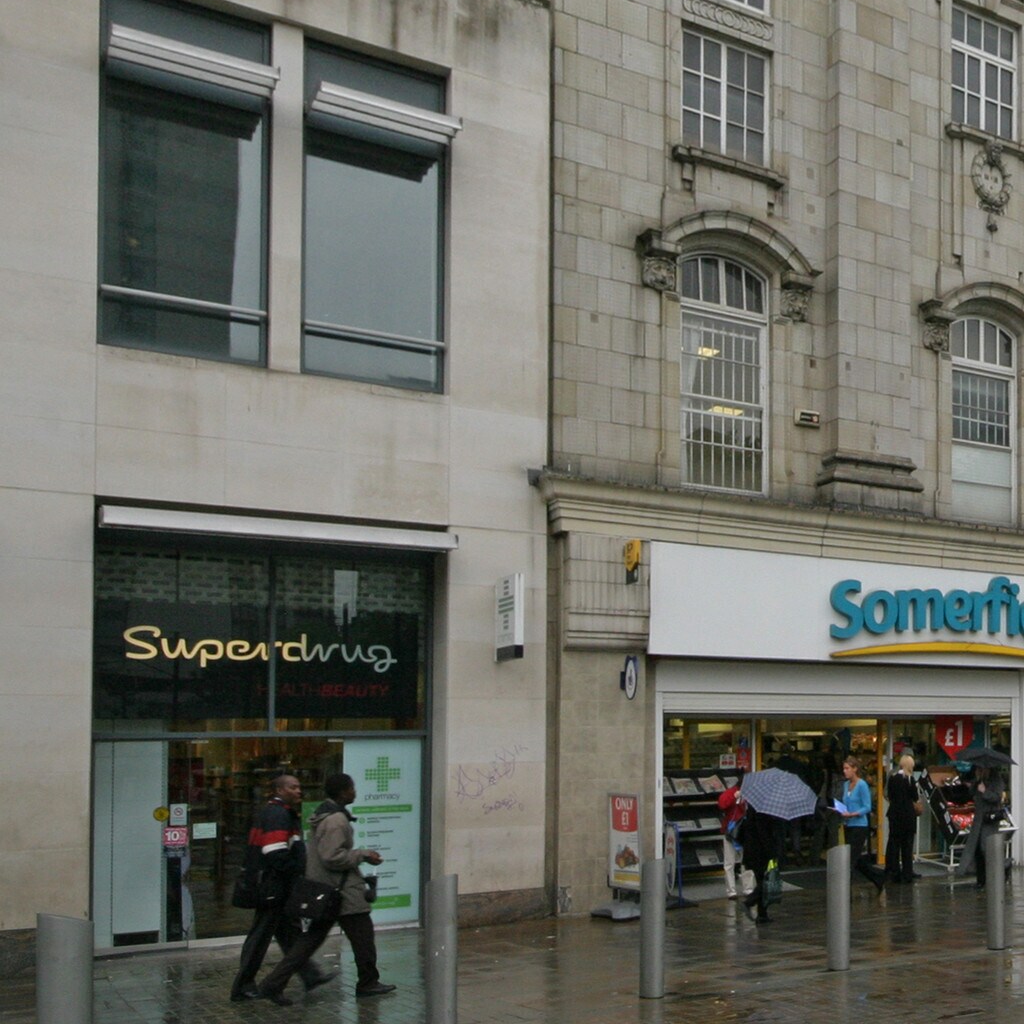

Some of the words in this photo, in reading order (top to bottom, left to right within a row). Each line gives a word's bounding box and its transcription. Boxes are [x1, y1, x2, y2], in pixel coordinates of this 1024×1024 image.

[123, 625, 398, 674] Superdrug
[944, 720, 963, 746] £1
[365, 792, 400, 802] pharmacy
[615, 797, 633, 810] ONLY
